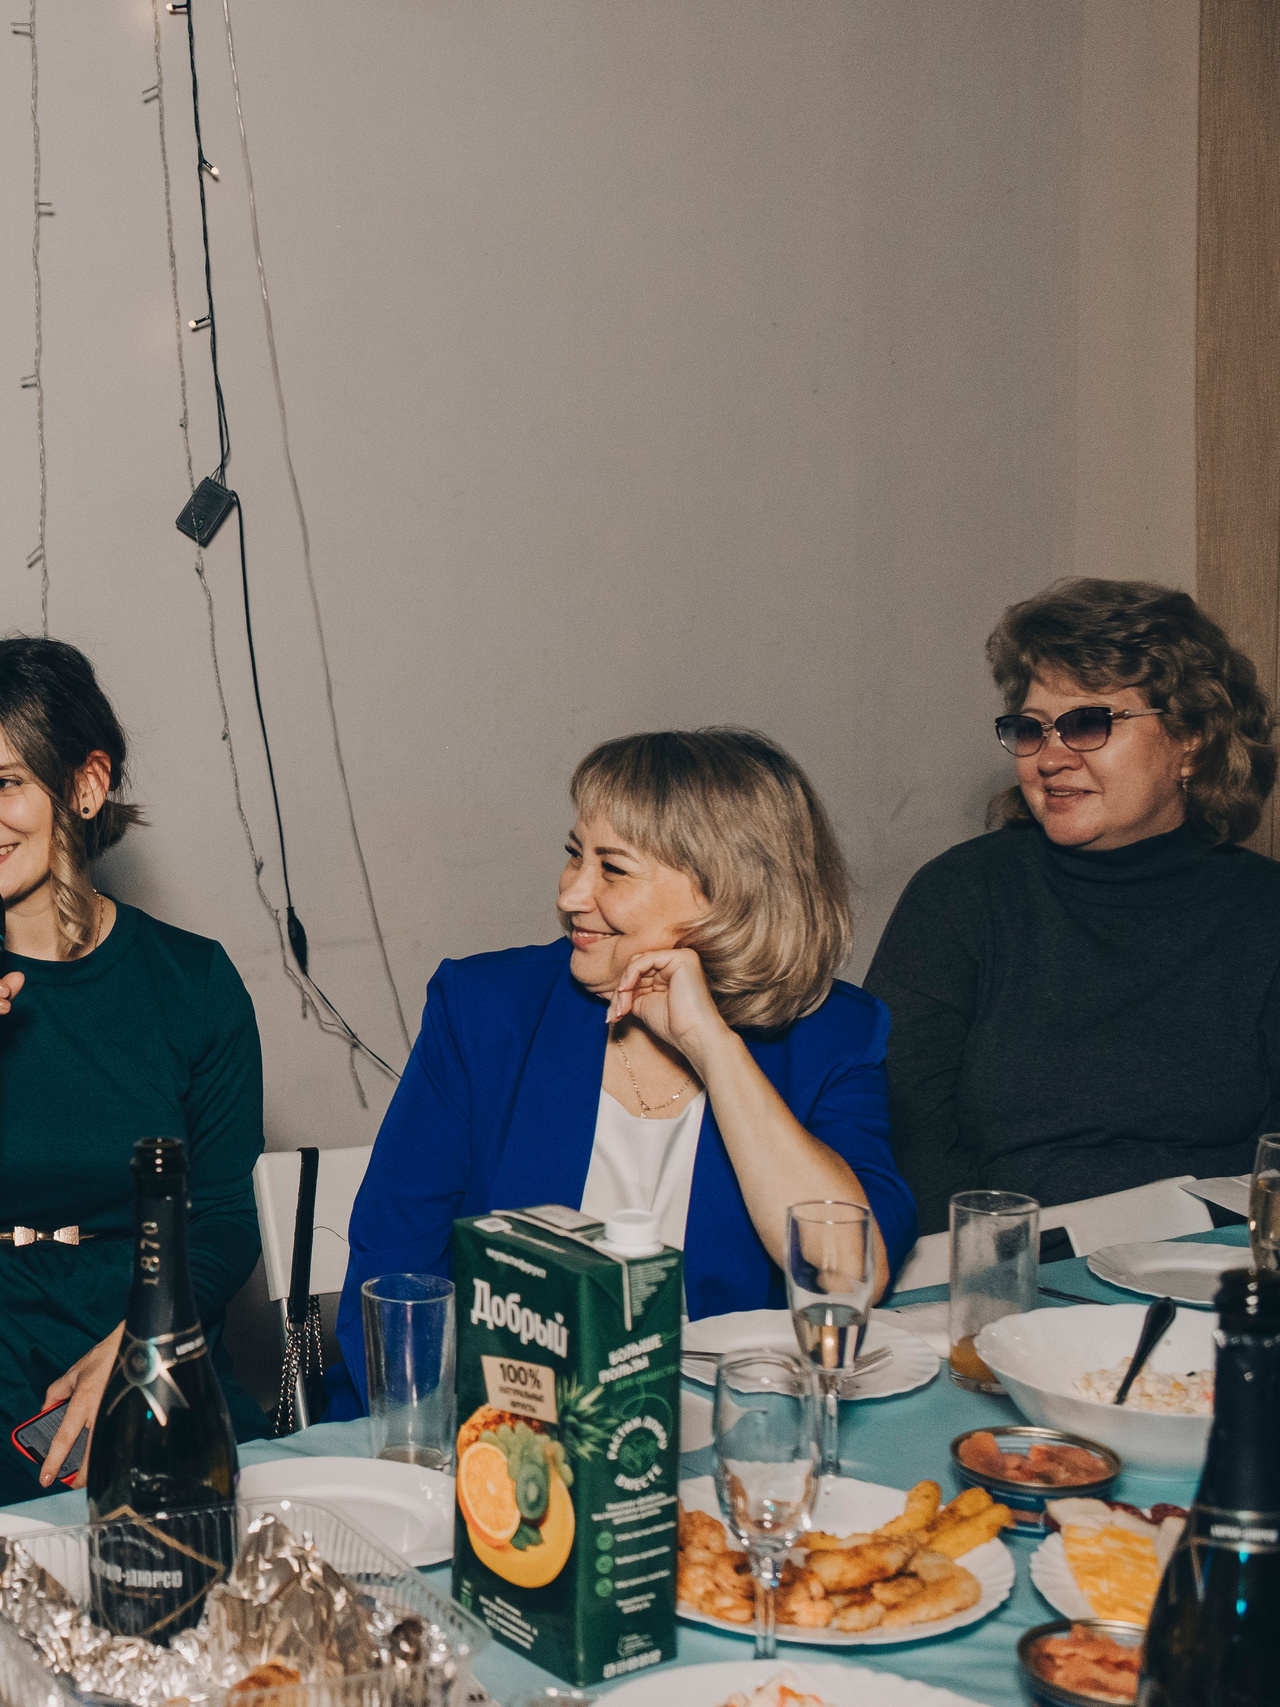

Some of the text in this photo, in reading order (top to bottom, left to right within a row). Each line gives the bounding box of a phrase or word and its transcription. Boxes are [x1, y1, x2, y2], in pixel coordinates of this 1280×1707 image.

[140, 1221, 161, 1286] 1870
[470, 1277, 568, 1359] Добрый
[608, 1333, 664, 1366] БОЛЬШЕ
[500, 1363, 542, 1390] 100%
[598, 1354, 650, 1384] ПОЛЬЗЫ
[607, 1415, 668, 1460] РАСТИМ ДОБРО
[614, 1463, 663, 1491] ВМЕСТЕ
